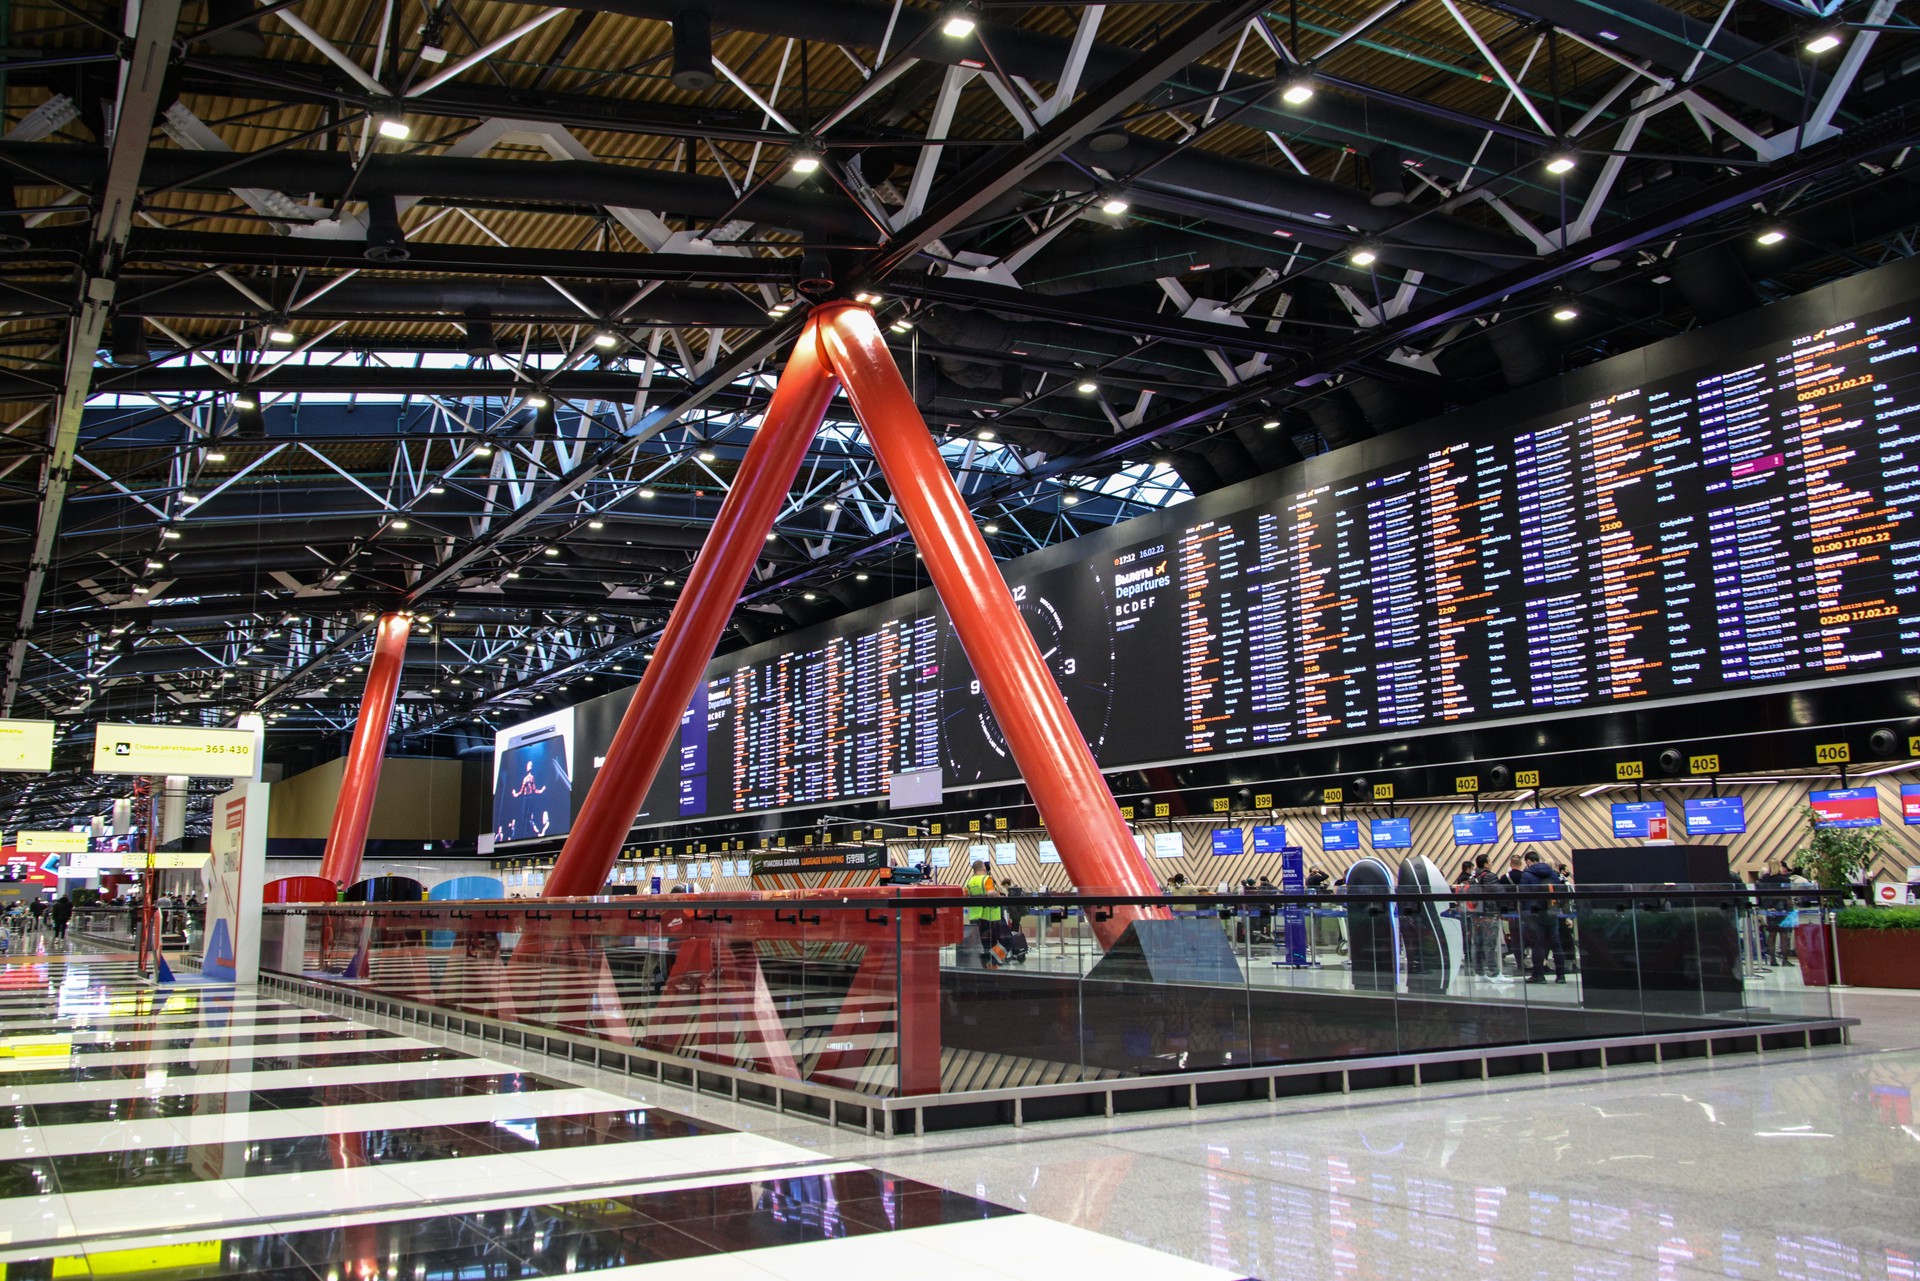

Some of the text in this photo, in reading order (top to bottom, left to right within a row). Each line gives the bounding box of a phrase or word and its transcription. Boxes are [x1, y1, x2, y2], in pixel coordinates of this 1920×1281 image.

[1868, 340, 1887, 349] Orsk
[1870, 345, 1918, 363] Ekaterinburg
[1798, 387, 1827, 401] 00:00
[1828, 374, 1874, 393] 17.02.22
[1650, 398, 1692, 414] Rostov-on-Don
[1874, 397, 1894, 406] Baku
[1652, 426, 1681, 439] Volgograd
[1878, 424, 1900, 434] Omsk
[1653, 438, 1691, 452] St.Petersburg
[1881, 453, 1904, 463] Dubai
[1882, 465, 1919, 477] Orenburg
[1656, 481, 1672, 490] Sochi
[1298, 511, 1312, 520] 20:00
[1887, 511, 1914, 521] Irkutsk
[1600, 521, 1623, 532] 23:00
[1662, 542, 1698, 554] Ekaterinburg
[1813, 532, 1891, 554] 01:00 17.02.22
[1120, 545, 1164, 564] 17:12 16.02.22
[1663, 558, 1686, 567] Yerevan
[1893, 571, 1920, 580] Surgut
[1116, 575, 1170, 598] Departures
[1665, 583, 1696, 593] Nur-Sultan
[1894, 586, 1917, 594] Sochi
[1013, 586, 1026, 600] 12
[1116, 597, 1155, 616] B C D E F
[1666, 598, 1690, 606] Tyumen
[1438, 606, 1457, 615] 22:00
[1820, 606, 1899, 625] 02:00 17.02.22
[1668, 624, 1691, 632] Sharjah
[1900, 631, 1920, 639] Male
[1670, 648, 1706, 658] Krasnoyarsk
[1065, 659, 1075, 674] 3
[1672, 663, 1700, 672] Orenburg
[970, 680, 980, 694] 9
[709, 697, 731, 710] Departures
[206, 744, 248, 754] 365-430
[1818, 747, 1847, 759] 406
[1692, 758, 1716, 770] 405
[1619, 764, 1641, 776] 404
[1458, 779, 1476, 790] 402
[1518, 774, 1537, 785] 403
[1326, 791, 1340, 800] 400
[1376, 787, 1391, 796] 401
[1215, 800, 1228, 808] 398
[1256, 797, 1270, 806] 399
[1122, 809, 1132, 817] 396
[1156, 806, 1168, 814] 397
[801, 857, 821, 865] LUGGAGE
[822, 856, 844, 864] WRAPPING
